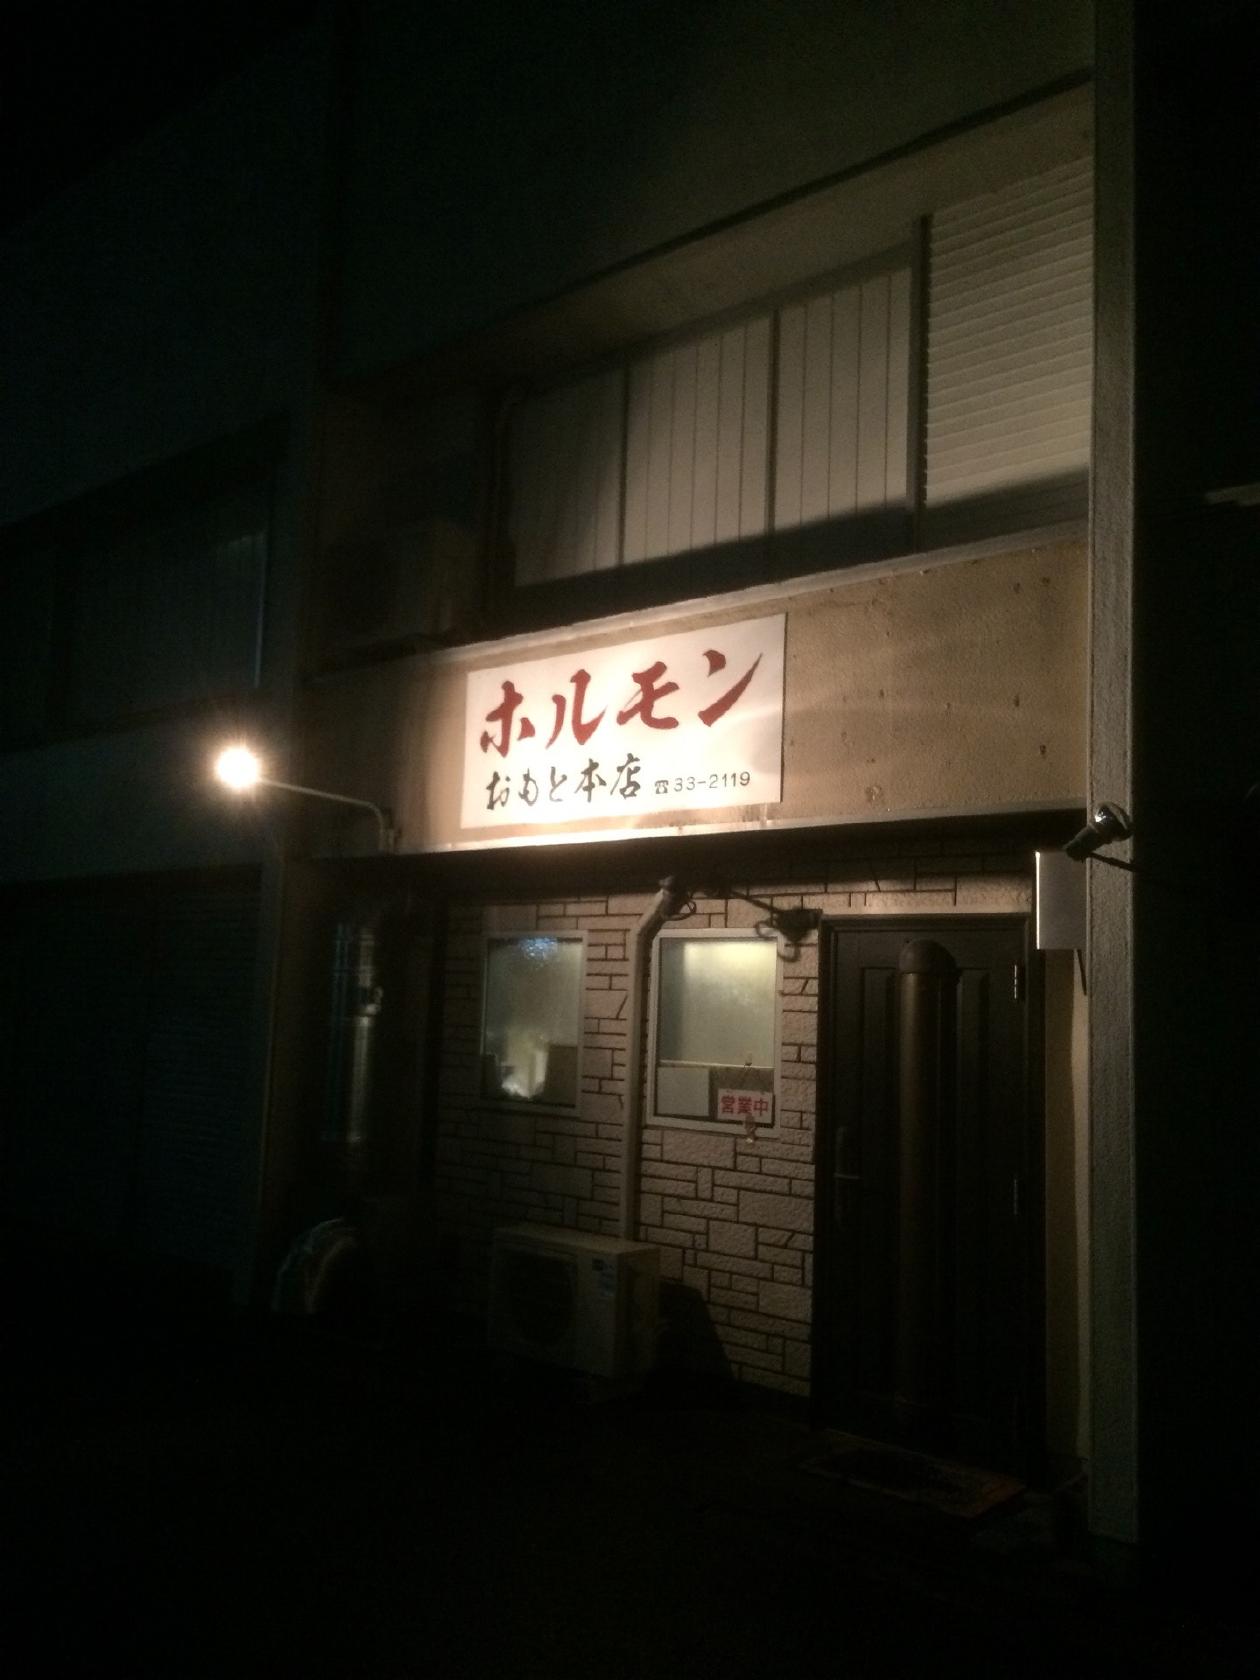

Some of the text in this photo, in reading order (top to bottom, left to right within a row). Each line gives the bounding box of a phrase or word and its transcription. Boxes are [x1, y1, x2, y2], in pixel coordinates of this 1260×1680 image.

[480, 649, 763, 757] ホルモン
[486, 754, 640, 809] おもと本店
[721, 1095, 768, 1116] 営業中
